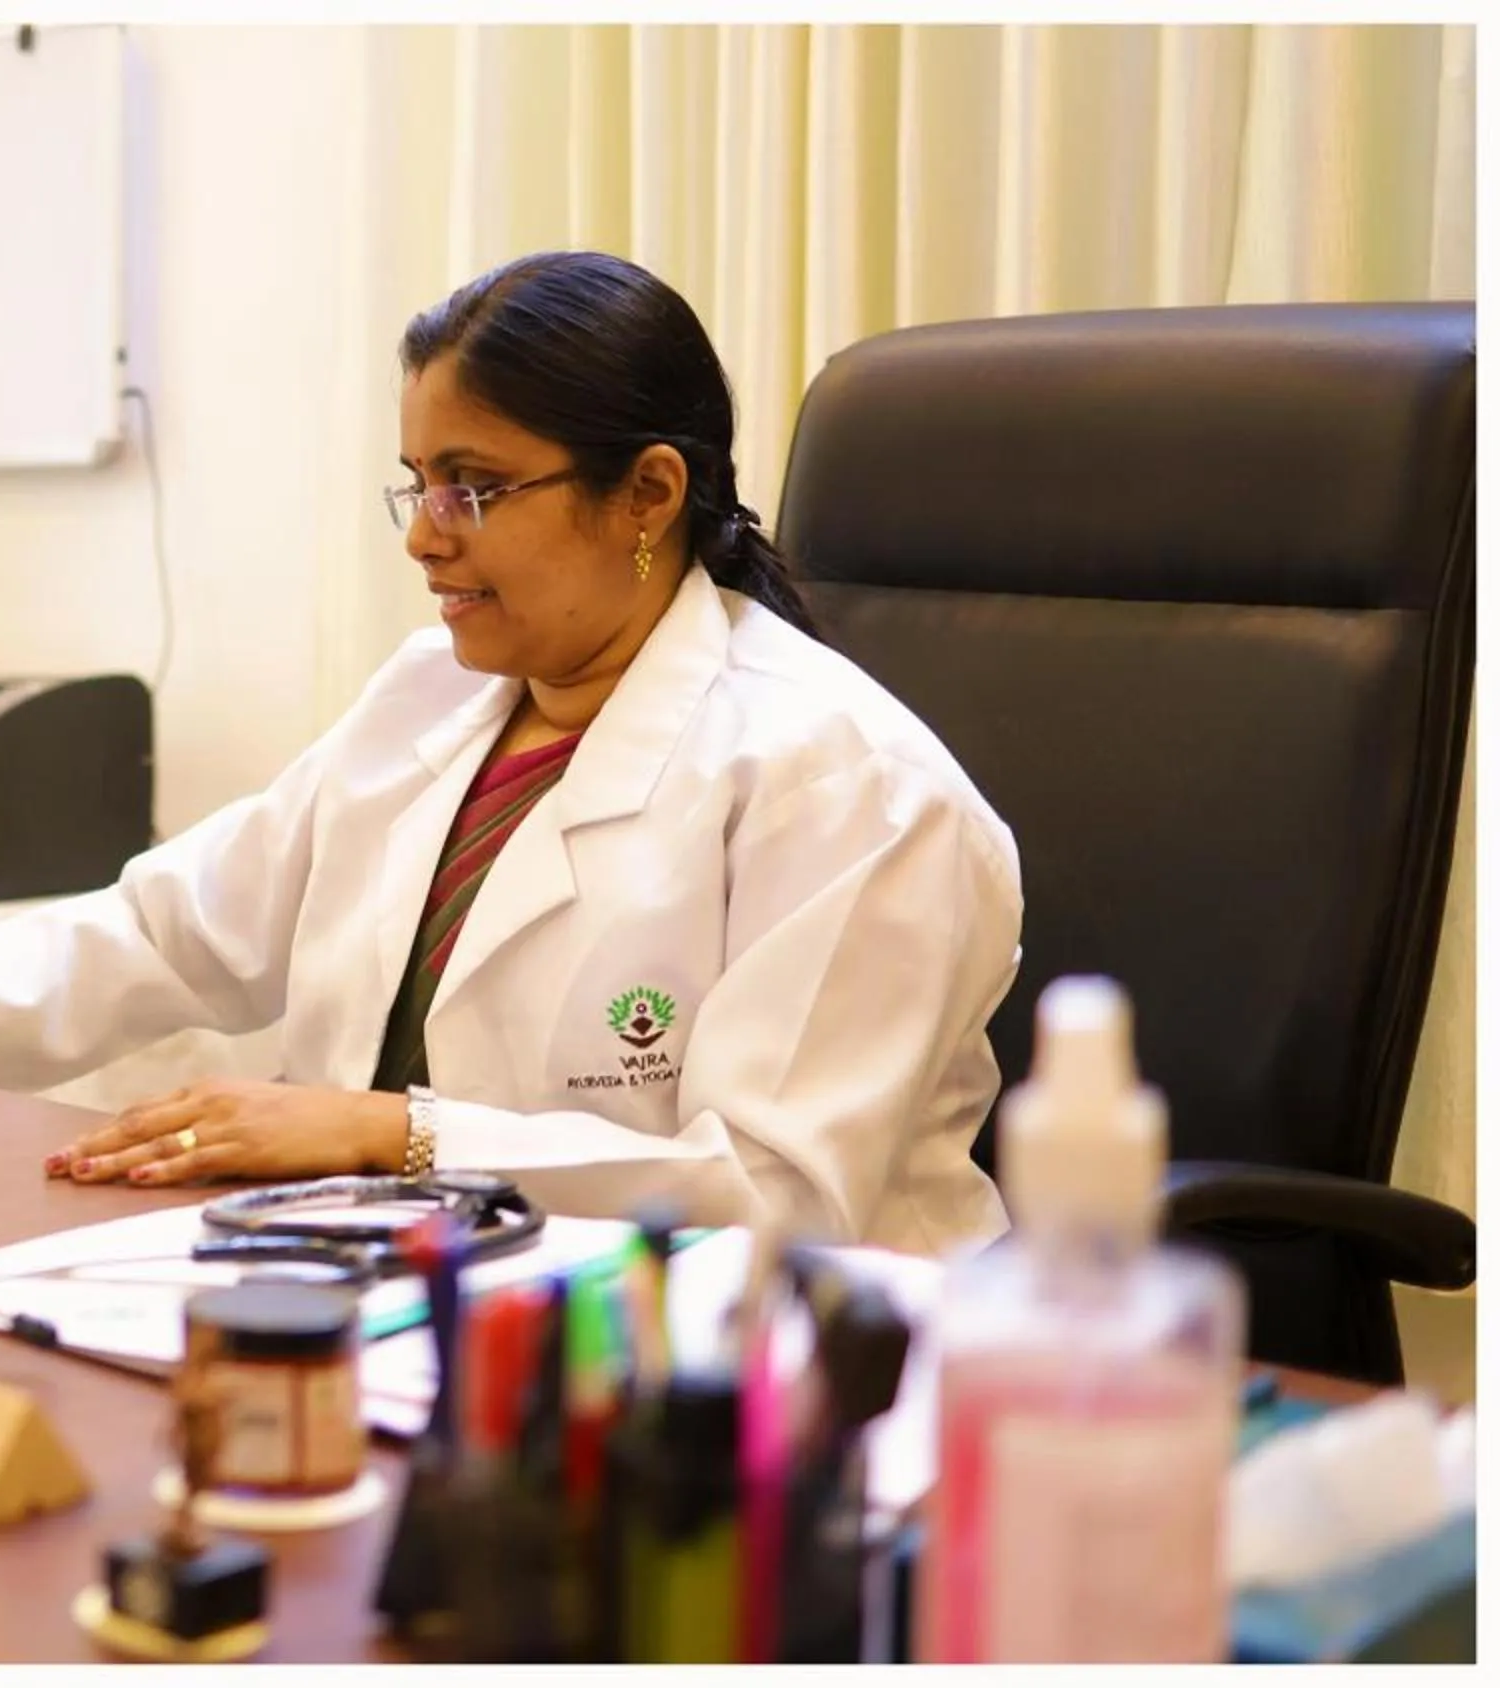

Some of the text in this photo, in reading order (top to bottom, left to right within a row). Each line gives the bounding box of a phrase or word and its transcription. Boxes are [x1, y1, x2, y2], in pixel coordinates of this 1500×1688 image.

[619, 1051, 670, 1071] VAJRA
[567, 1075, 625, 1089] AYURVEDA
[629, 1074, 638, 1087] &
[641, 1069, 675, 1085] YOGA
